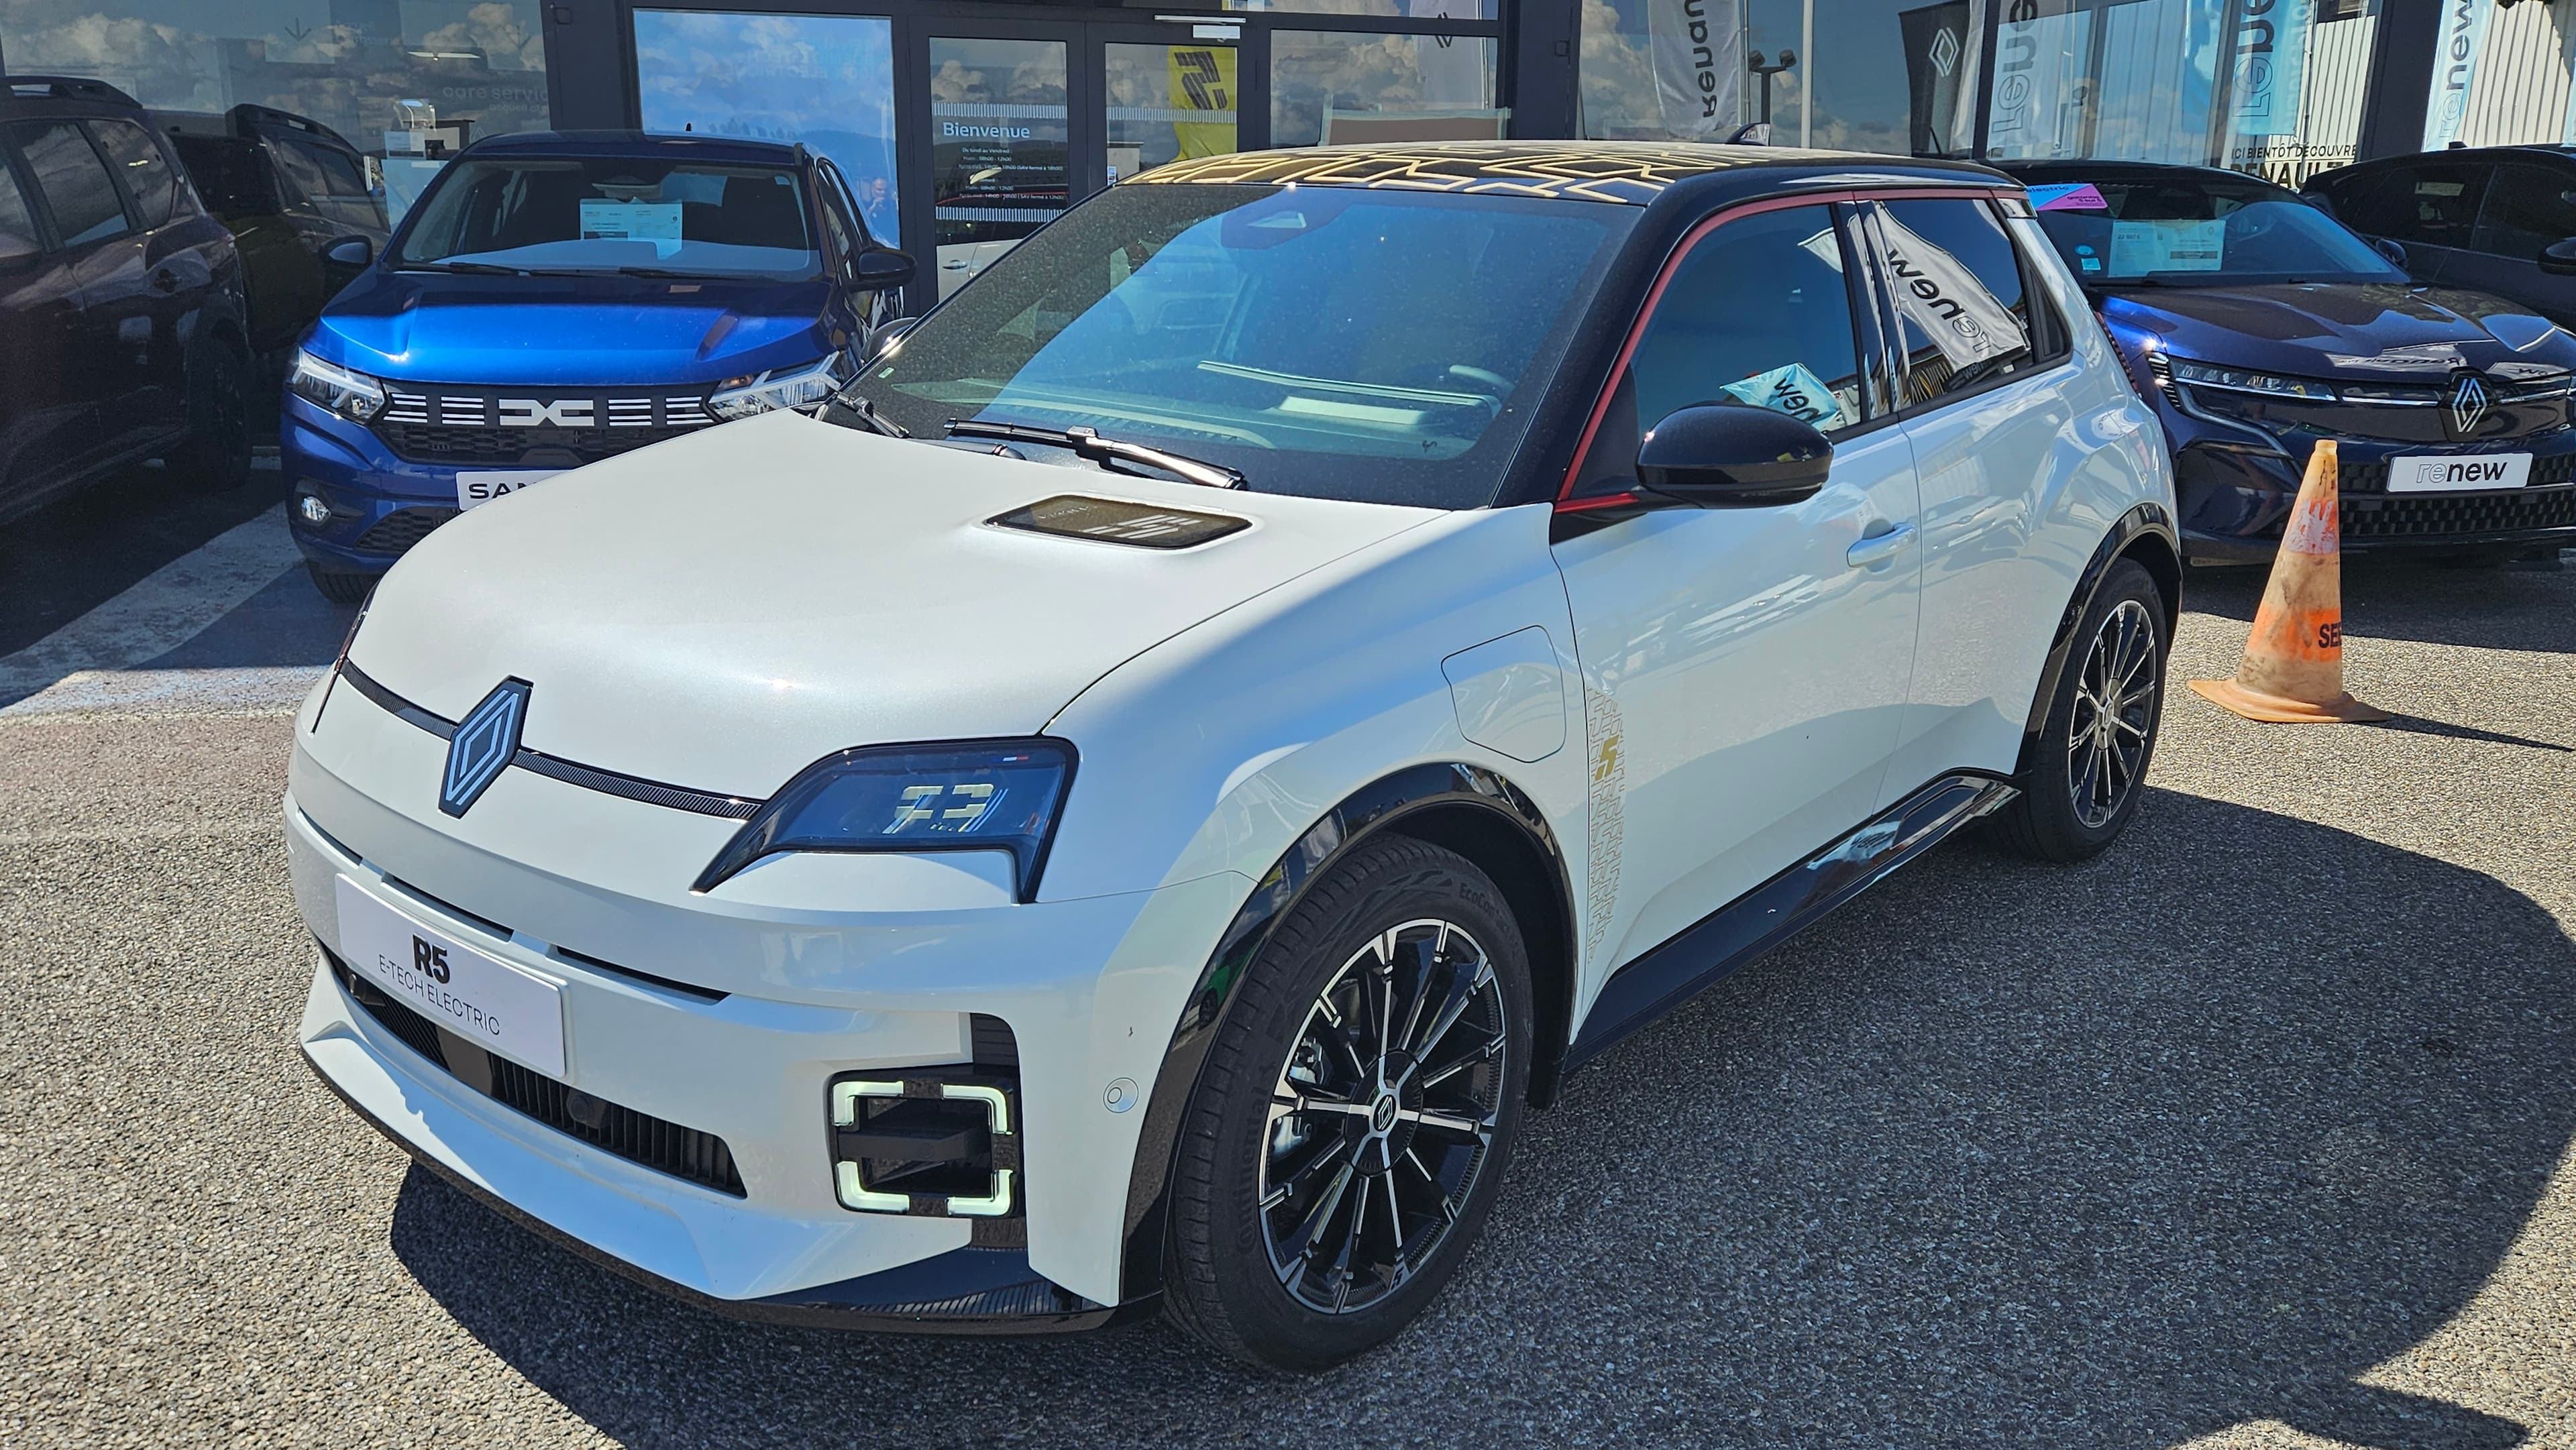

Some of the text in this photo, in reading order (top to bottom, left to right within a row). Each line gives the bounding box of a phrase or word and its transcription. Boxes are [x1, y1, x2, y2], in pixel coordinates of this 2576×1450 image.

[943, 121, 1030, 139] Bienvenue
[2231, 148, 2245, 160] ICI
[2247, 144, 2294, 159] BIENTÔT
[2416, 461, 2508, 484] renew
[412, 933, 451, 985] R5
[378, 954, 500, 1036] E-TECH ELECTRIC
